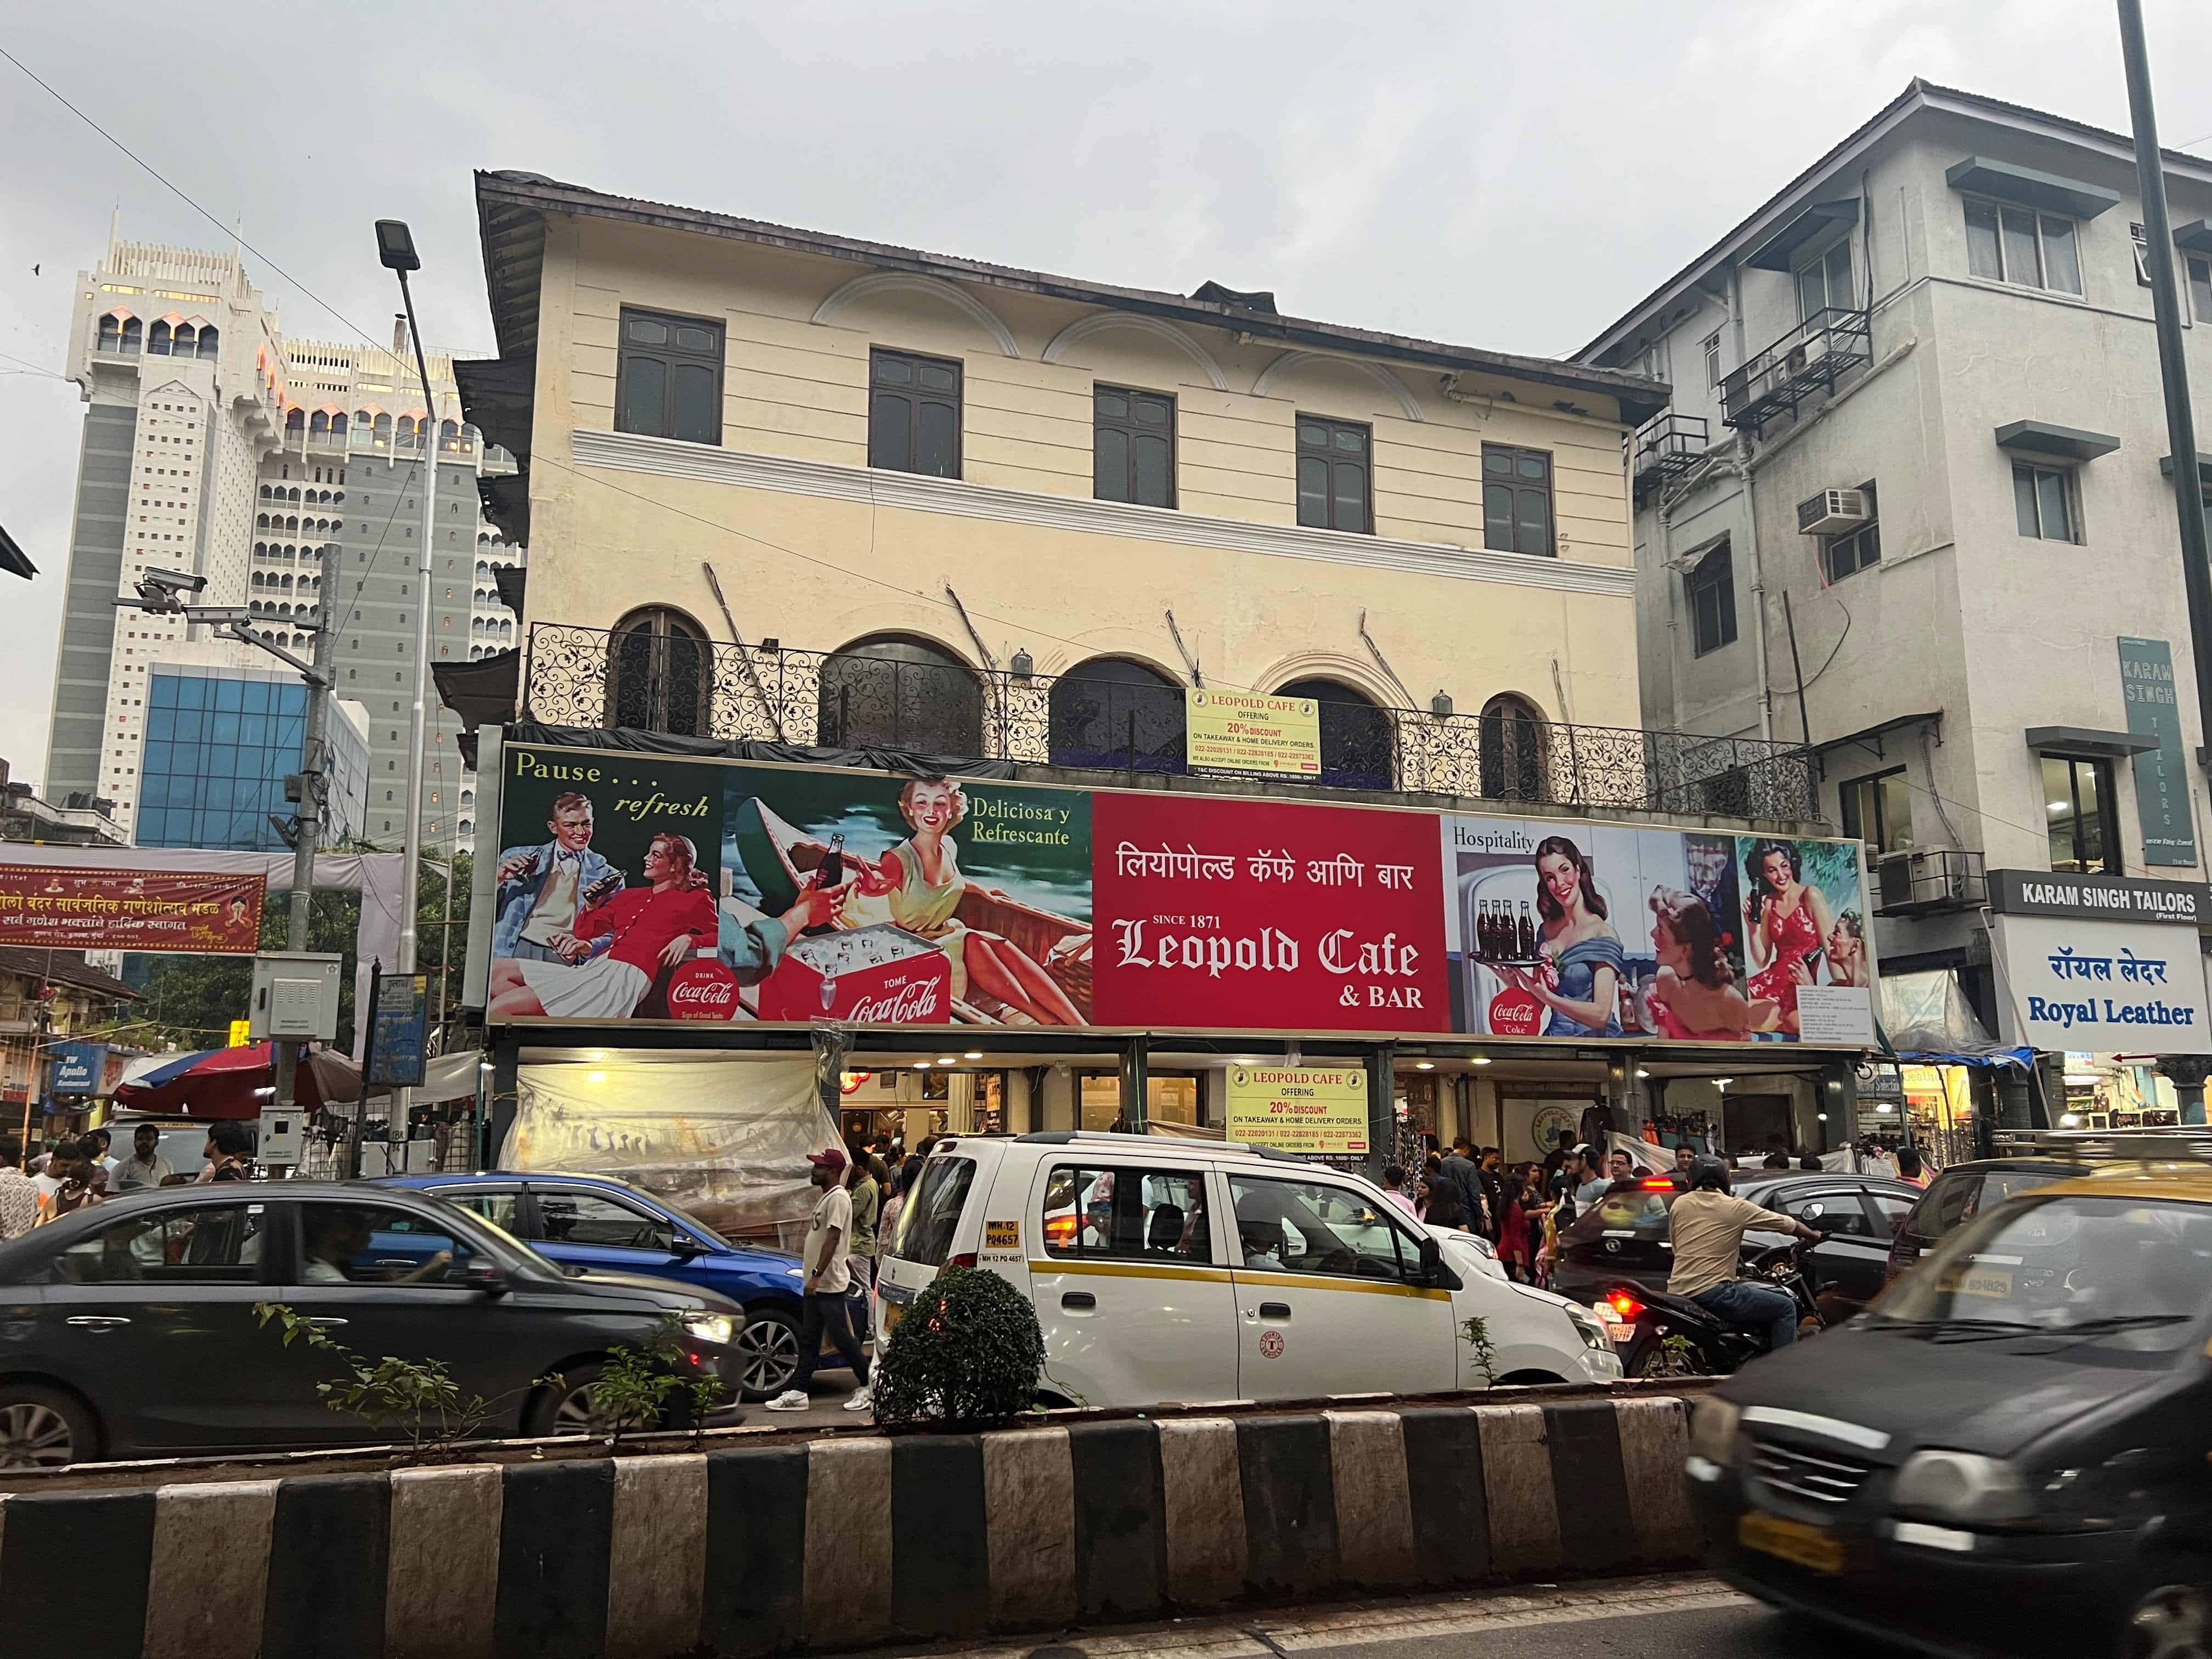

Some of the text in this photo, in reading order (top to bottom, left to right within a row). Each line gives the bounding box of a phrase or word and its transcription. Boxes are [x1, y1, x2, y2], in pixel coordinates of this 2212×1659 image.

[2123, 660, 2173, 681] KARAM
[1211, 695, 1296, 712] LEOPOLD CAFE
[2126, 684, 2175, 704] SINGH
[1238, 711, 1269, 720] OFFERING
[1204, 733, 1235, 742] TAKEAWAY
[1227, 723, 1282, 737] 20% DISCOUNT
[516, 752, 601, 783] Pause
[2151, 717, 2171, 826] TILORS
[614, 792, 709, 821] refresh
[973, 797, 1070, 823] Deliciosa y
[973, 820, 1070, 845] Refrescante
[1454, 826, 1534, 854] Hospitality
[1115, 841, 1414, 890] लियोपोल्ड कॅफे आणि बार
[56, 892, 121, 913] सार्वजनिक
[123, 895, 188, 916] गणेशोत्सव
[192, 899, 221, 916] मंडळ
[2022, 883, 2079, 905] KARAM
[2083, 887, 2130, 909] SINGH
[2134, 891, 2196, 913] TAILORS
[3, 913, 24, 925] सर्व
[26, 914, 58, 927] गणेश
[148, 921, 187, 930] स्वागत
[1153, 915, 1220, 929] SINCE 1871
[1111, 918, 1419, 979] Leopold Cafe
[2048, 946, 2167, 985] रॉयल लेदर
[884, 975, 906, 989] TOME
[1339, 985, 1424, 1008] & BAR
[2028, 997, 2193, 1028] Royal Leather
[59, 1065, 87, 1077] Apollo
[1254, 1073, 1342, 1084] LEOPOLD CAFE
[1282, 1088, 1314, 1096] OFFERING
[1270, 1102, 1327, 1114] 20% DISCOUNT
[987, 1234, 1018, 1246] PQ4657
[1268, 1340, 1276, 1350] T
